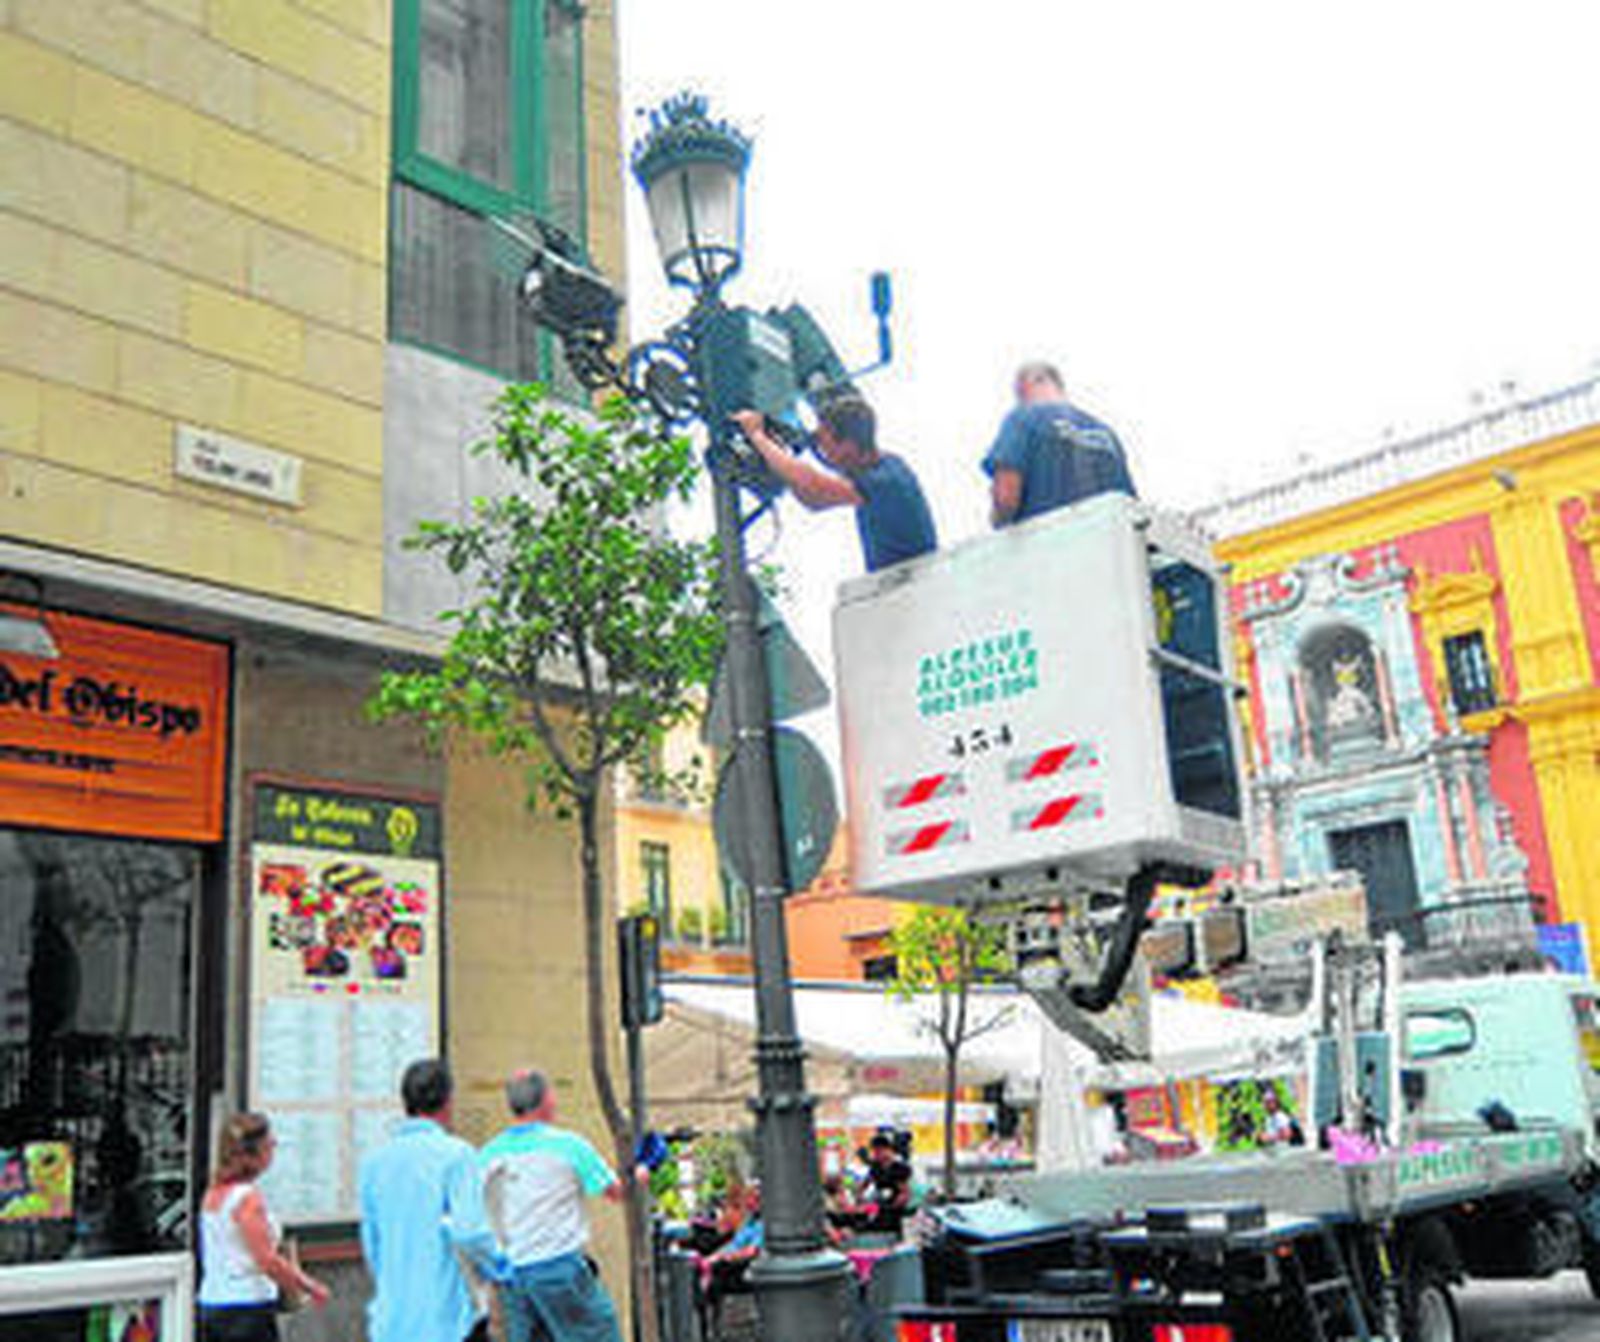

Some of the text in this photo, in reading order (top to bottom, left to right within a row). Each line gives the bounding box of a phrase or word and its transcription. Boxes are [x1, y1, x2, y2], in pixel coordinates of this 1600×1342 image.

[917, 649, 1039, 696] ALQUILER
[919, 629, 1032, 675] ALPESUR
[63, 675, 202, 737] Obispo
